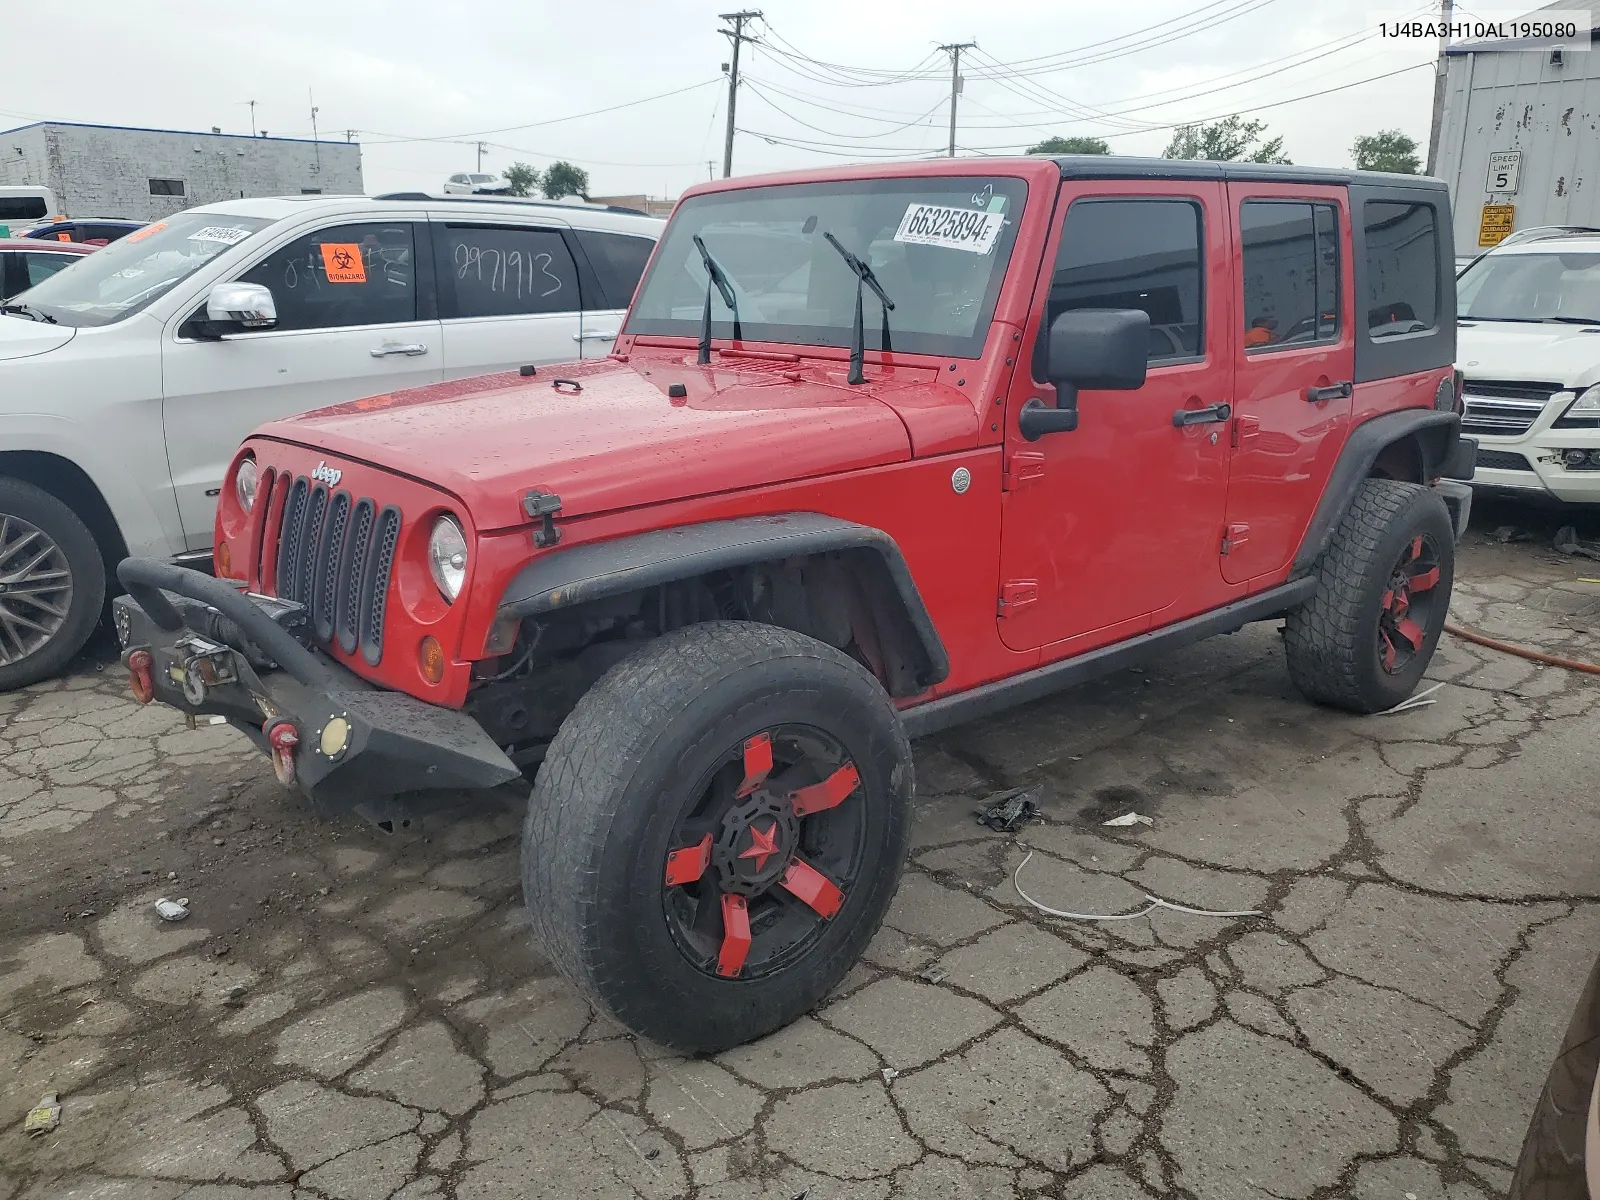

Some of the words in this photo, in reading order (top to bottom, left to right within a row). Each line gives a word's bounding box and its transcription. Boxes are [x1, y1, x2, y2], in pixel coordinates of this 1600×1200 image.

[1496, 173, 1508, 188] 5
[908, 207, 988, 242] 66325894
[981, 225, 992, 241] E
[311, 460, 342, 488] Jeep
